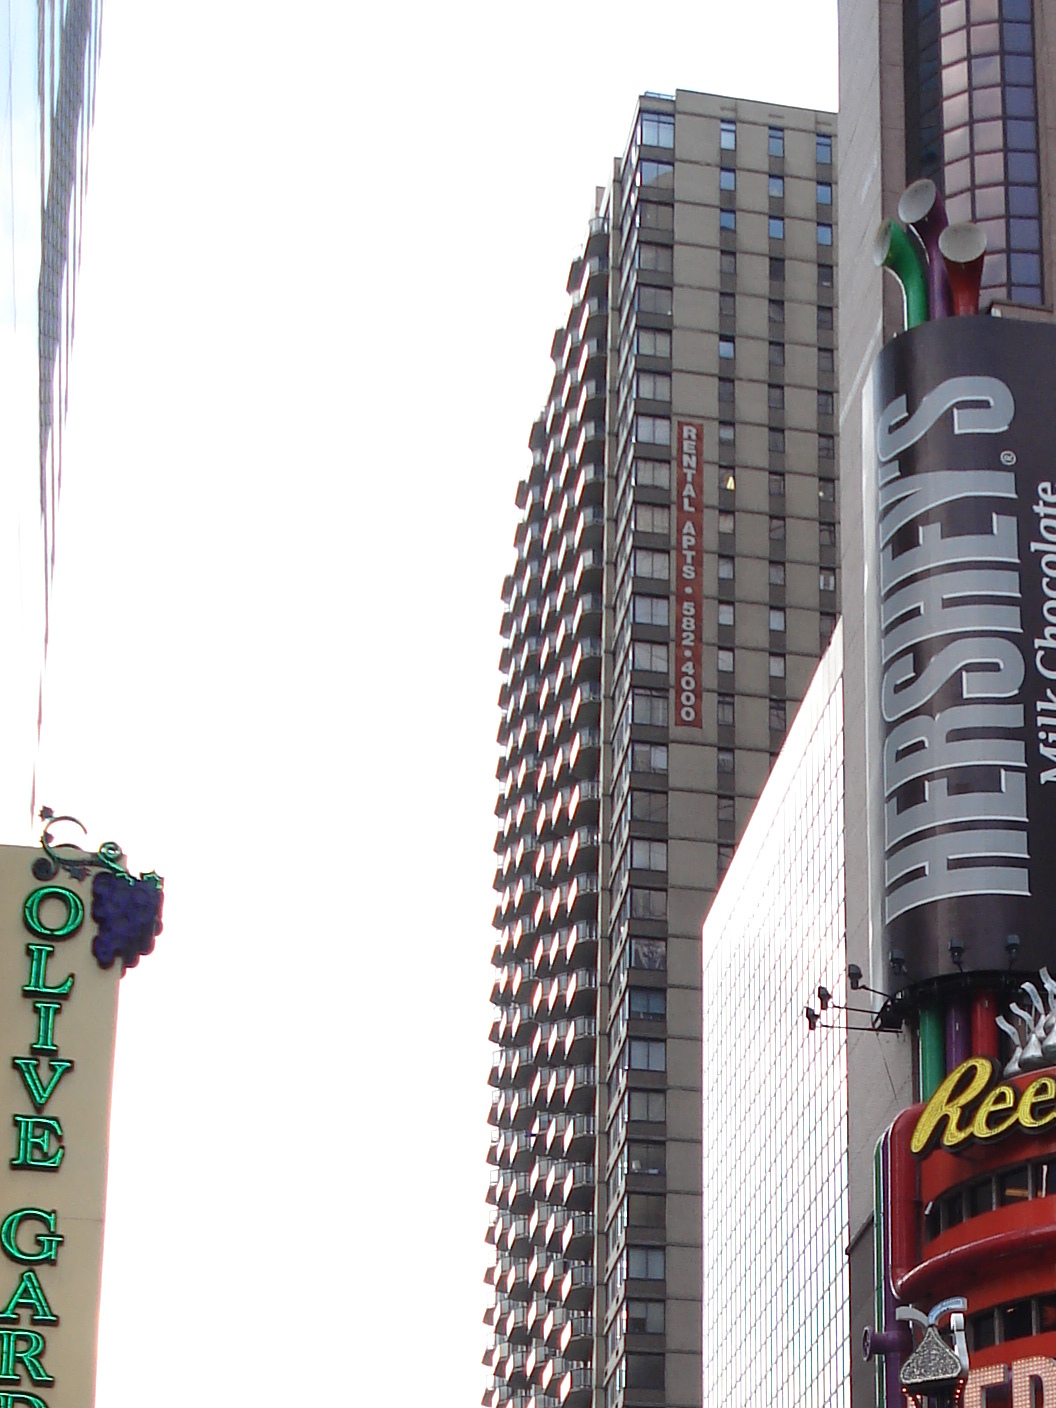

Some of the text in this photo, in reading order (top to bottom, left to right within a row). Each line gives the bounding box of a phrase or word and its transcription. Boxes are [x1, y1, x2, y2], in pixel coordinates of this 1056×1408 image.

[682, 424, 698, 512] RENTAL
[682, 523, 697, 580] APTS
[877, 374, 1031, 924] HERSHEY'S
[9, 881, 86, 1173] OLIVE
